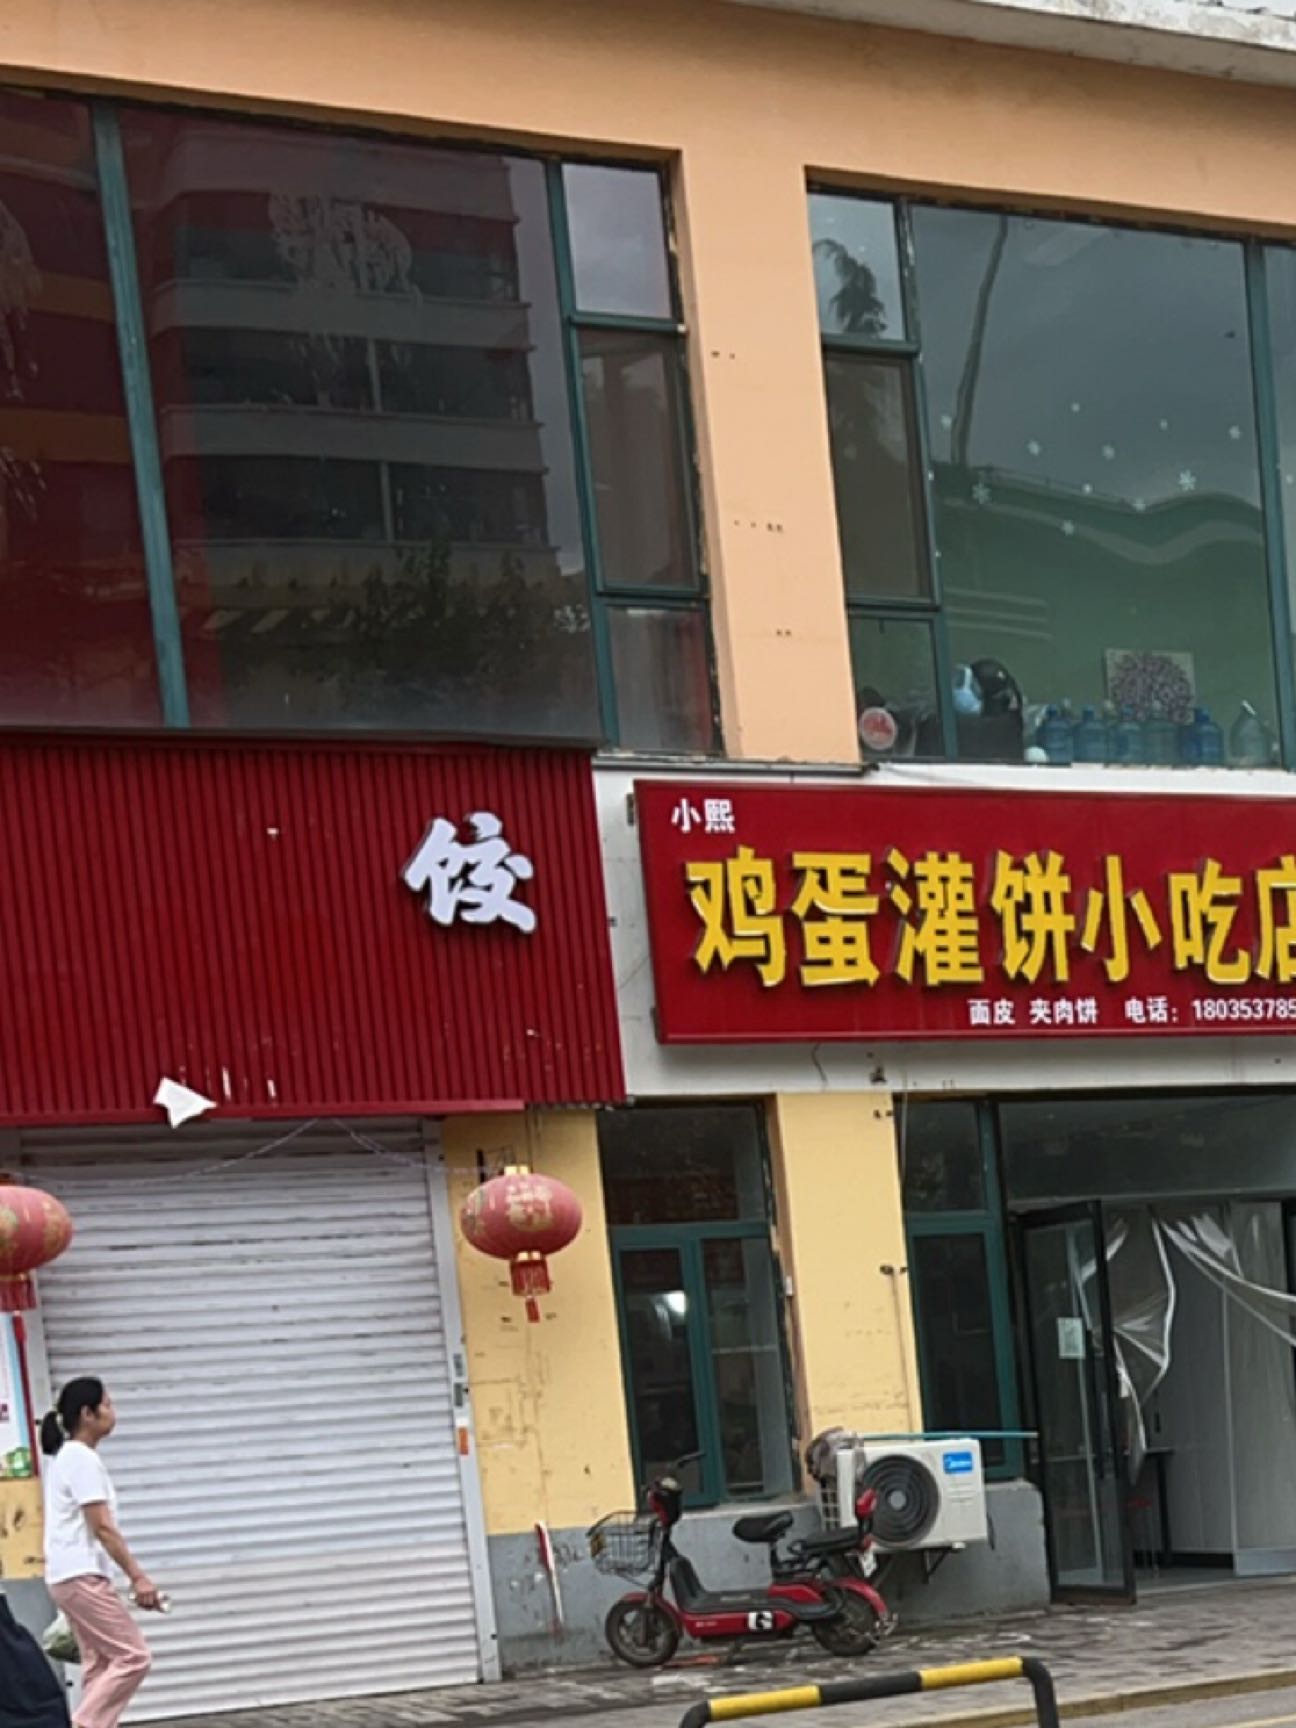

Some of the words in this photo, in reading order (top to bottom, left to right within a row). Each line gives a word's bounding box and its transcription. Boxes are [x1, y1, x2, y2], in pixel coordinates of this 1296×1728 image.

[671, 798, 735, 833] 小熙
[968, 999, 1015, 1025] 面皮
[1029, 998, 1098, 1024] 夹肉饼
